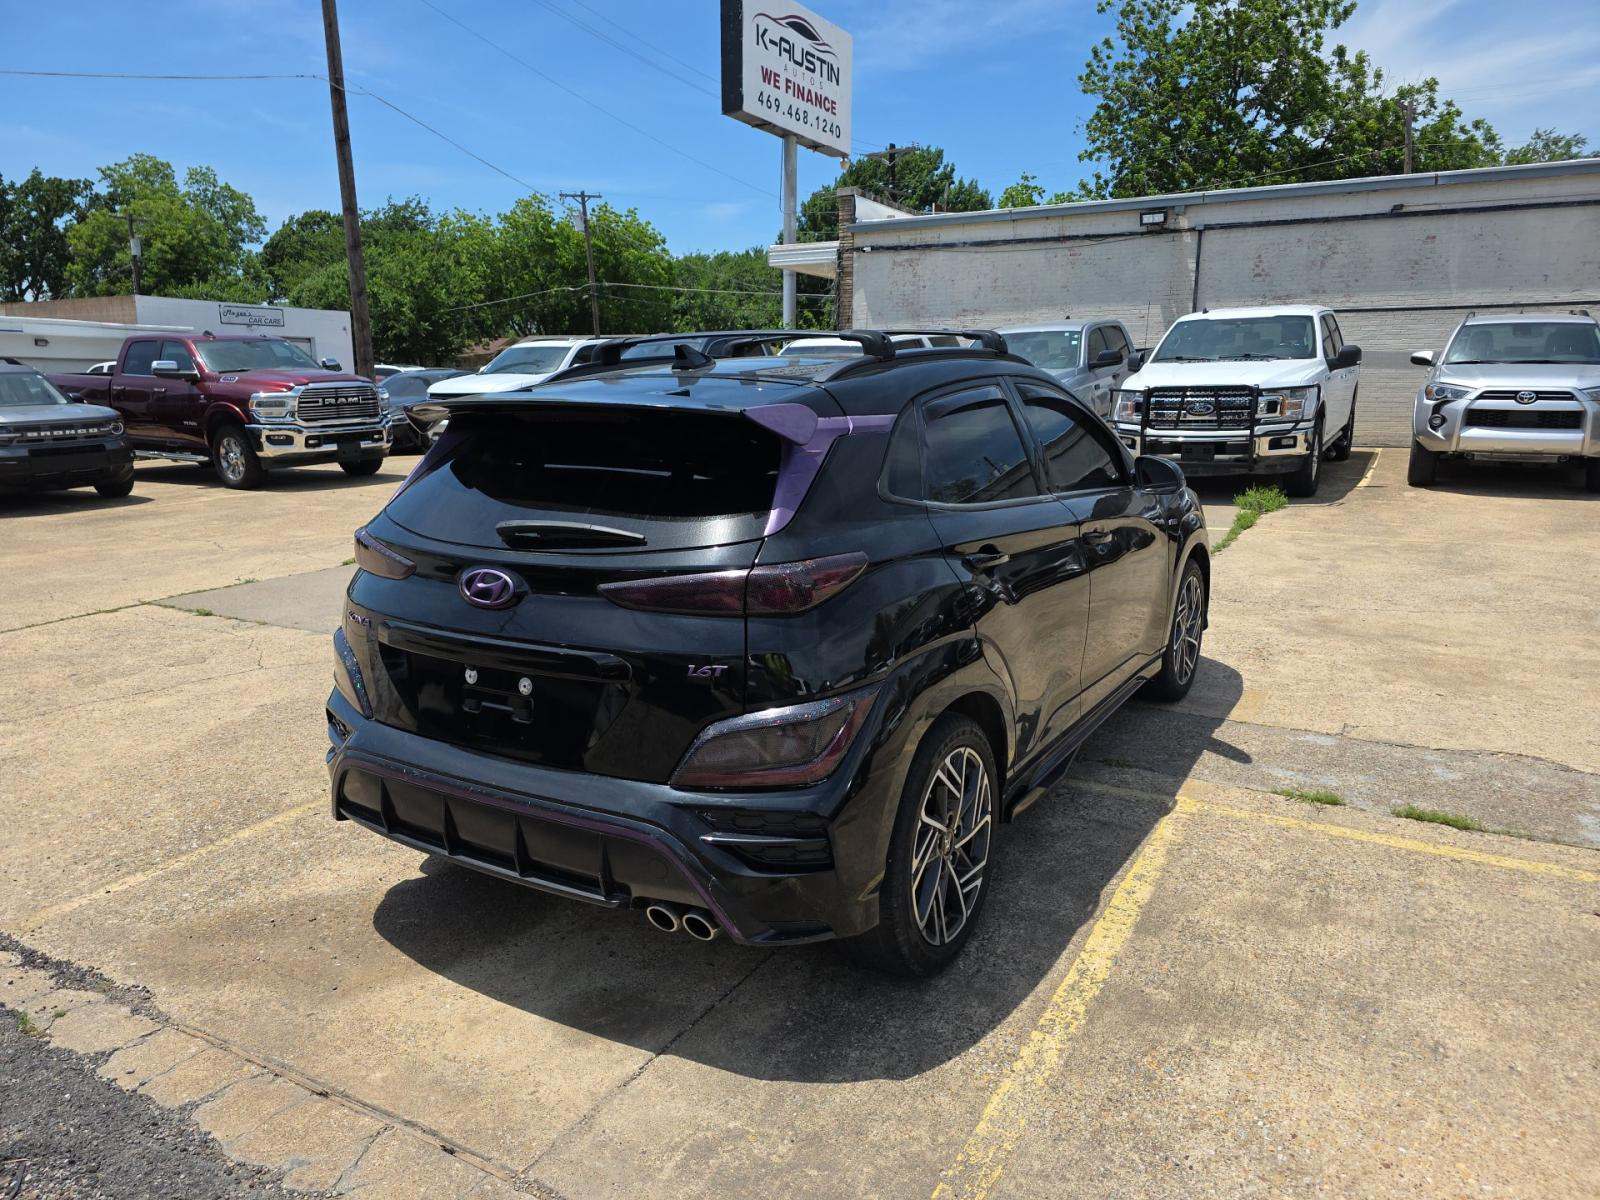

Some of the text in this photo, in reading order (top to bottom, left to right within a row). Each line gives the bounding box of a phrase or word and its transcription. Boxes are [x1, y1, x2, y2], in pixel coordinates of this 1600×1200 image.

[756, 23, 840, 86] K-AUSTIN
[761, 65, 837, 116] WE FINANCE
[758, 91, 841, 139] 469.468.1240
[248, 316, 281, 325] CAR CARE
[324, 396, 360, 406] RAM
